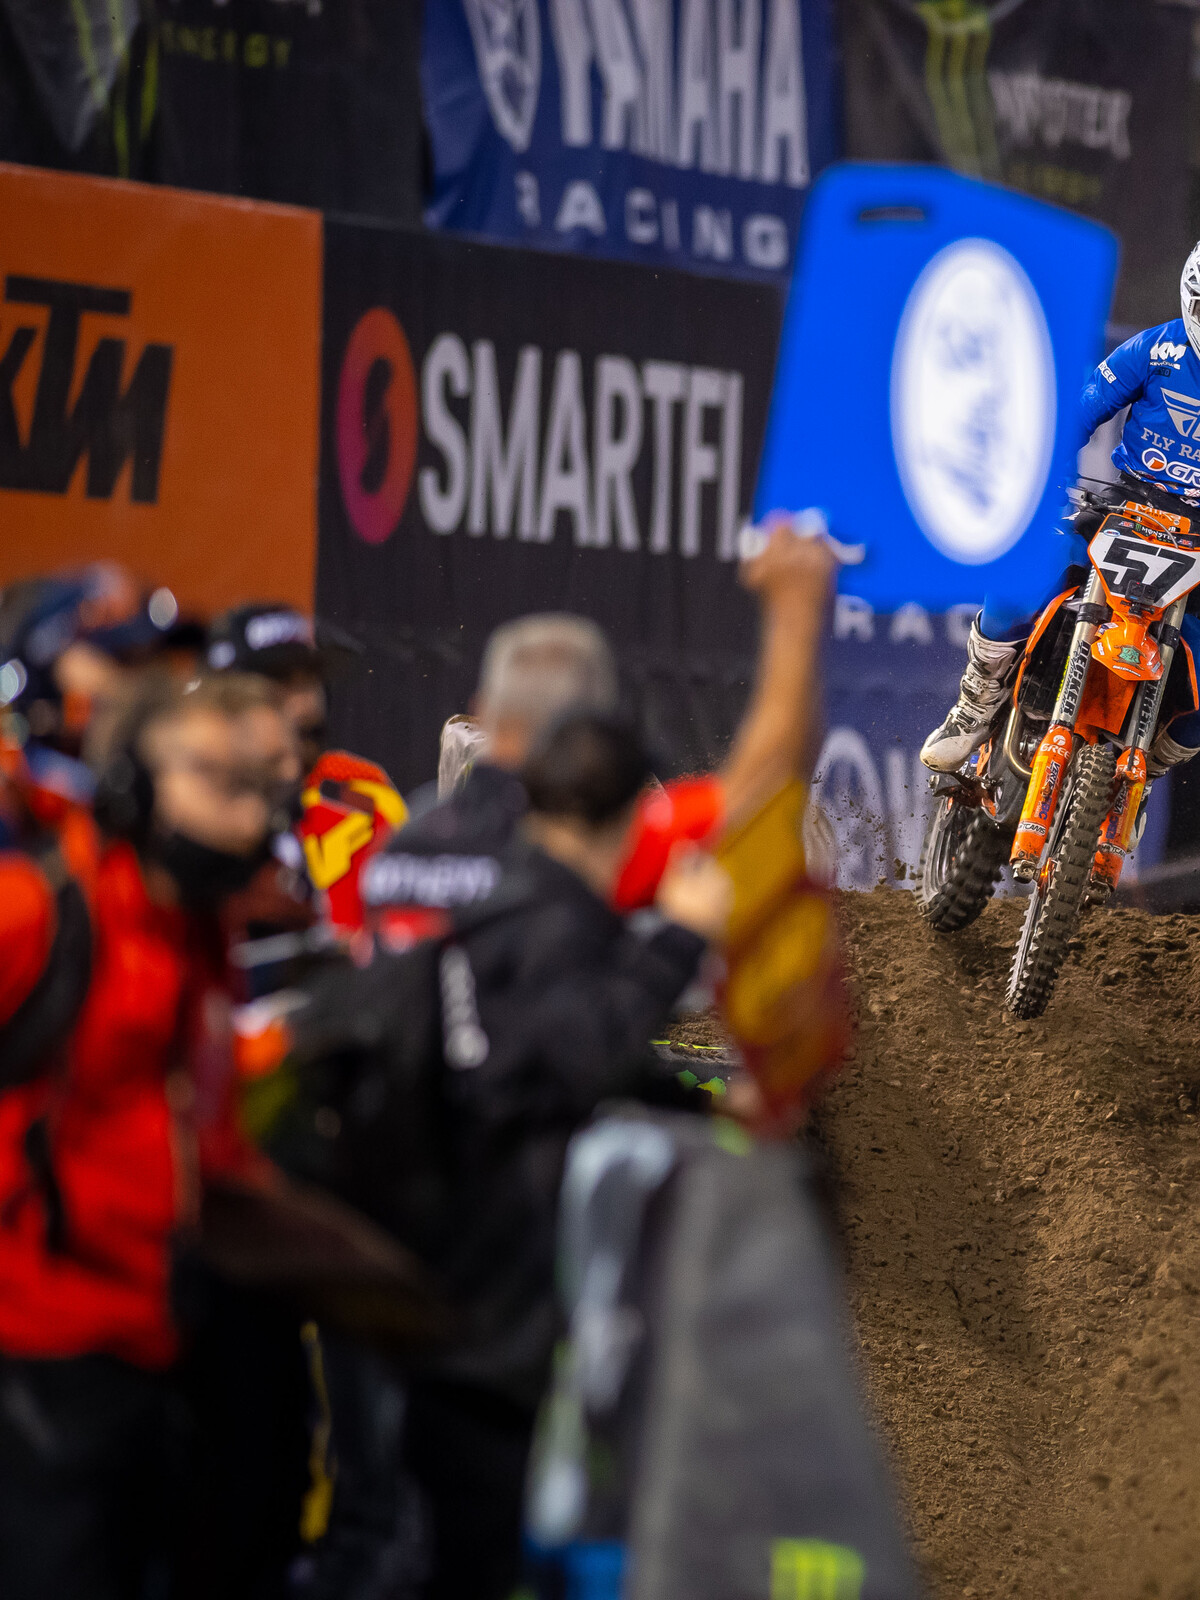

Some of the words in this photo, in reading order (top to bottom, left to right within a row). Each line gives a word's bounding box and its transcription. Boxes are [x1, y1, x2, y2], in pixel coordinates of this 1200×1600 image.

[1141, 427, 1175, 452] FLY
[1099, 537, 1196, 604] 57
[1039, 743, 1072, 759] GREE
